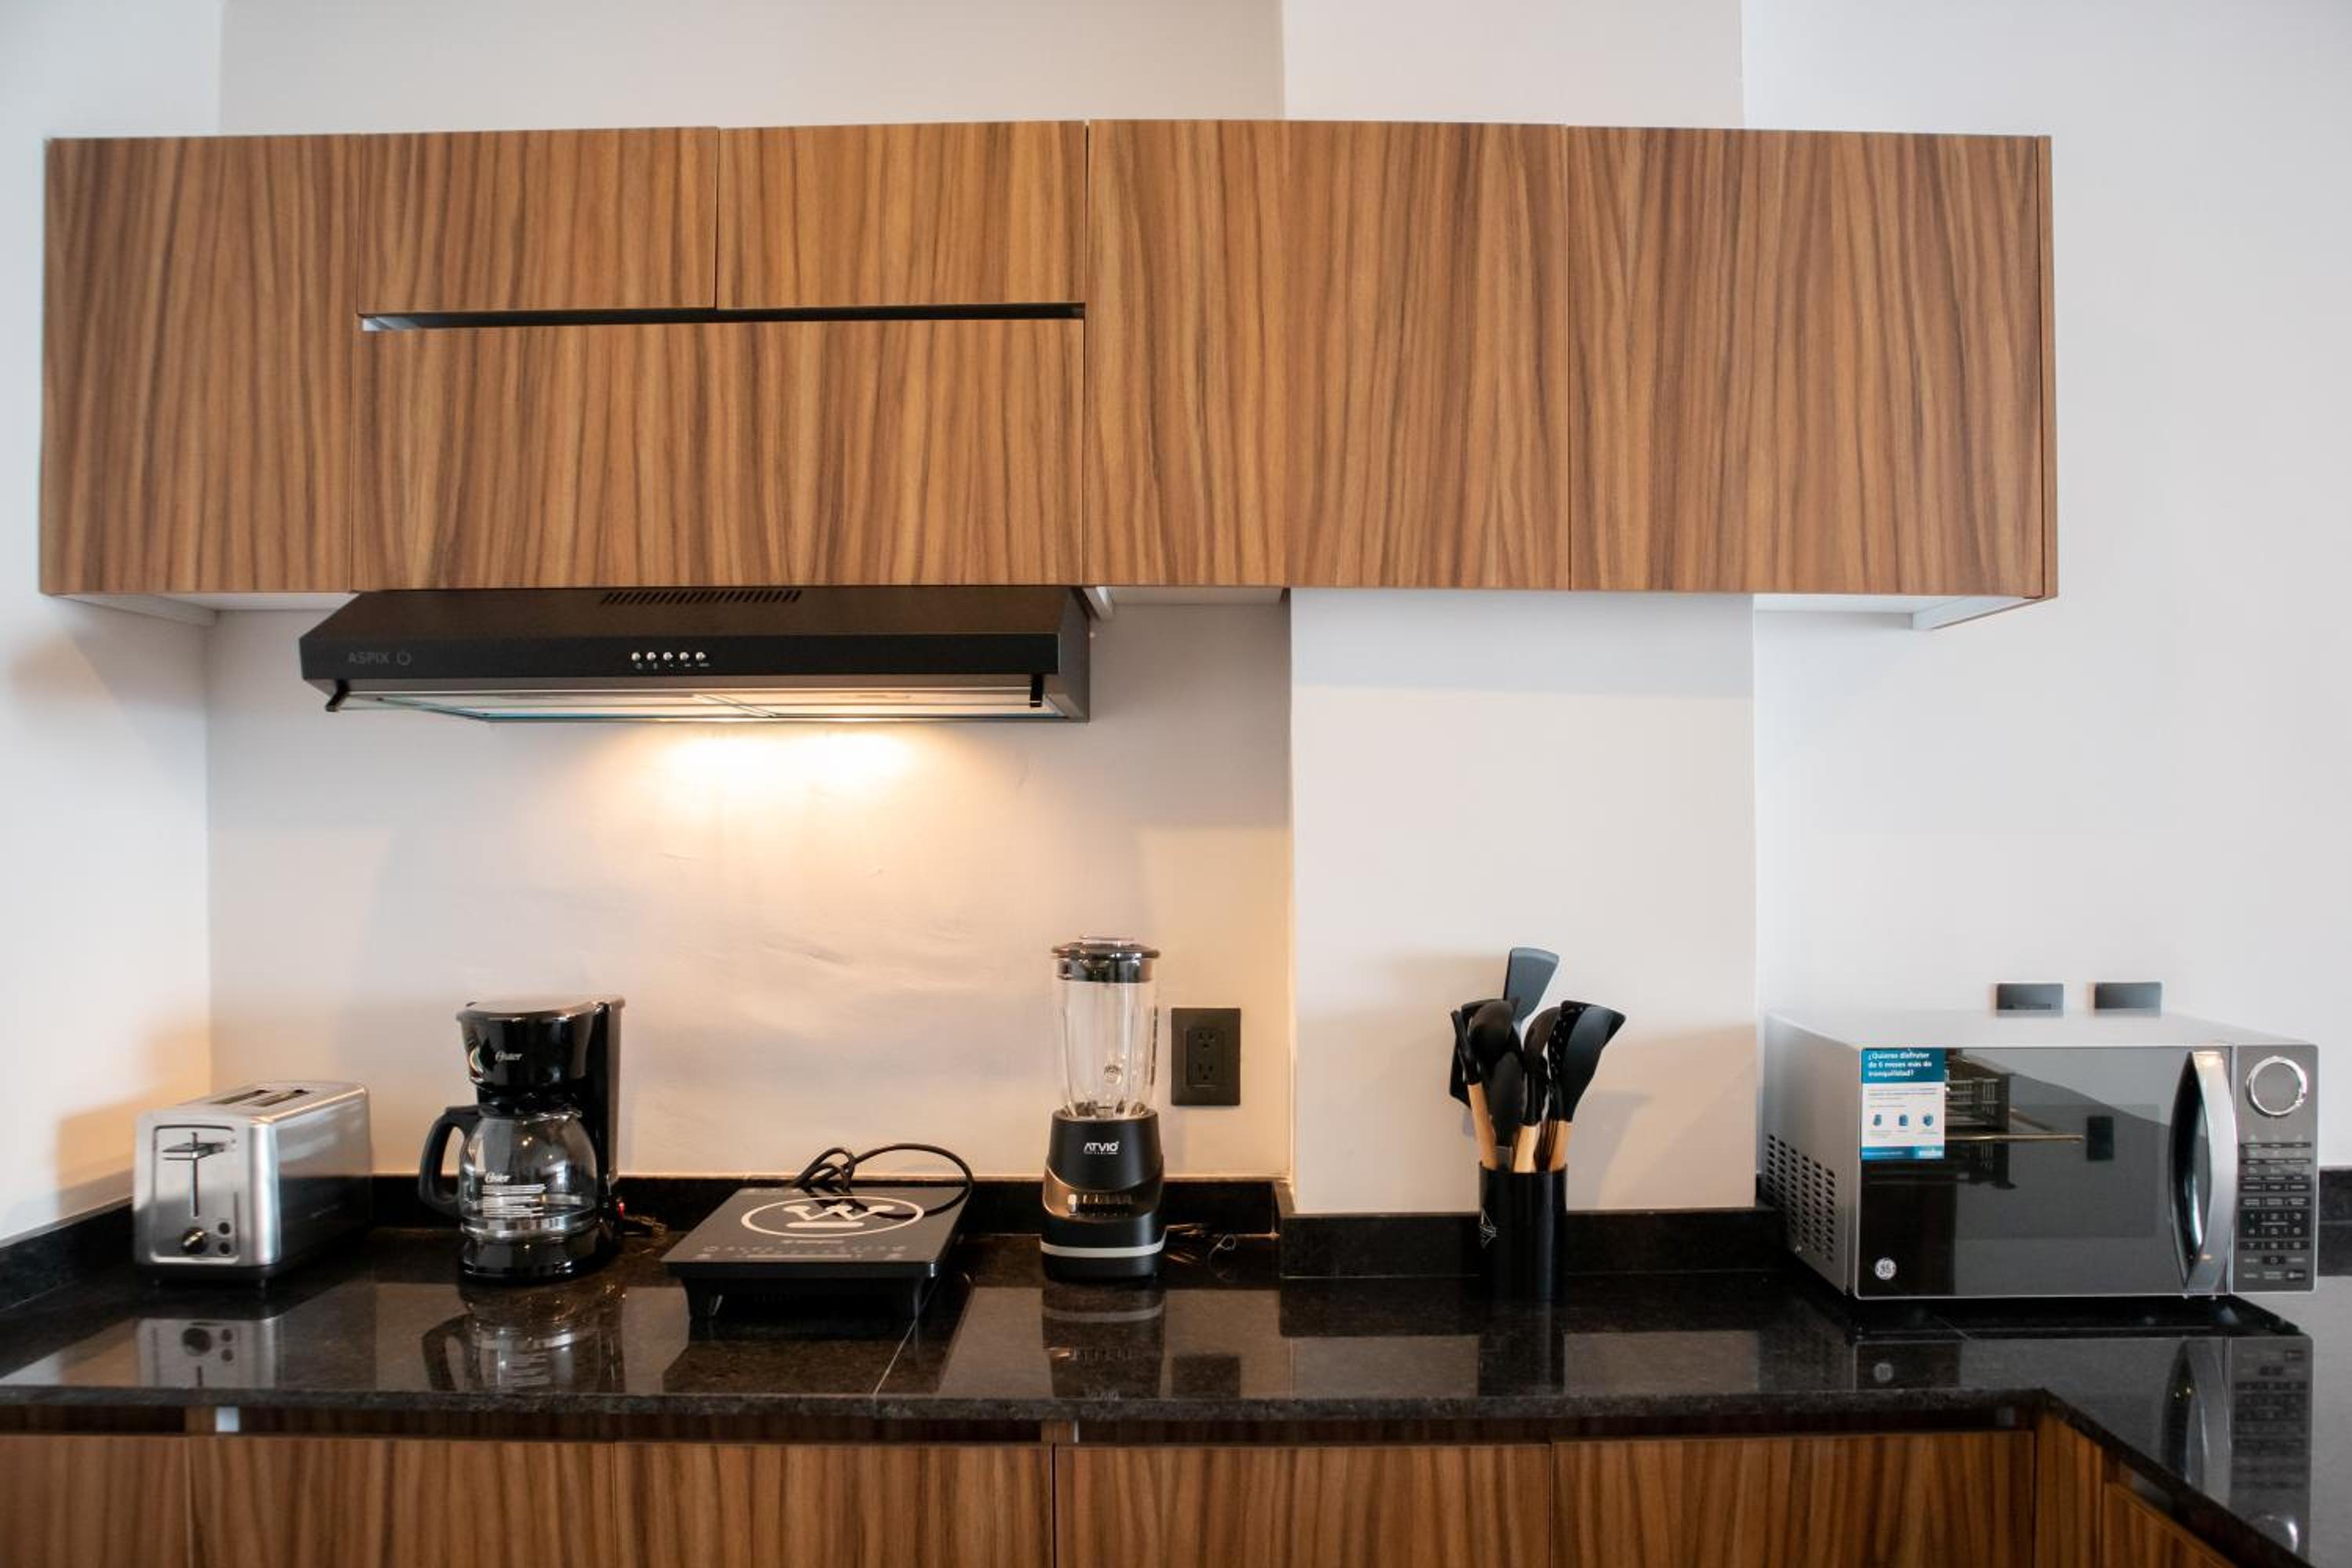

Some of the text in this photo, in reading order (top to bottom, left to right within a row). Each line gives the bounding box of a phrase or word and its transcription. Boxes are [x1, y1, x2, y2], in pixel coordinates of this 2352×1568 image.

[348, 652, 390, 665] ASPIX
[495, 1051, 523, 1062] Oster
[1083, 1142, 1119, 1152] ATVIO
[485, 1171, 511, 1184] Oster
